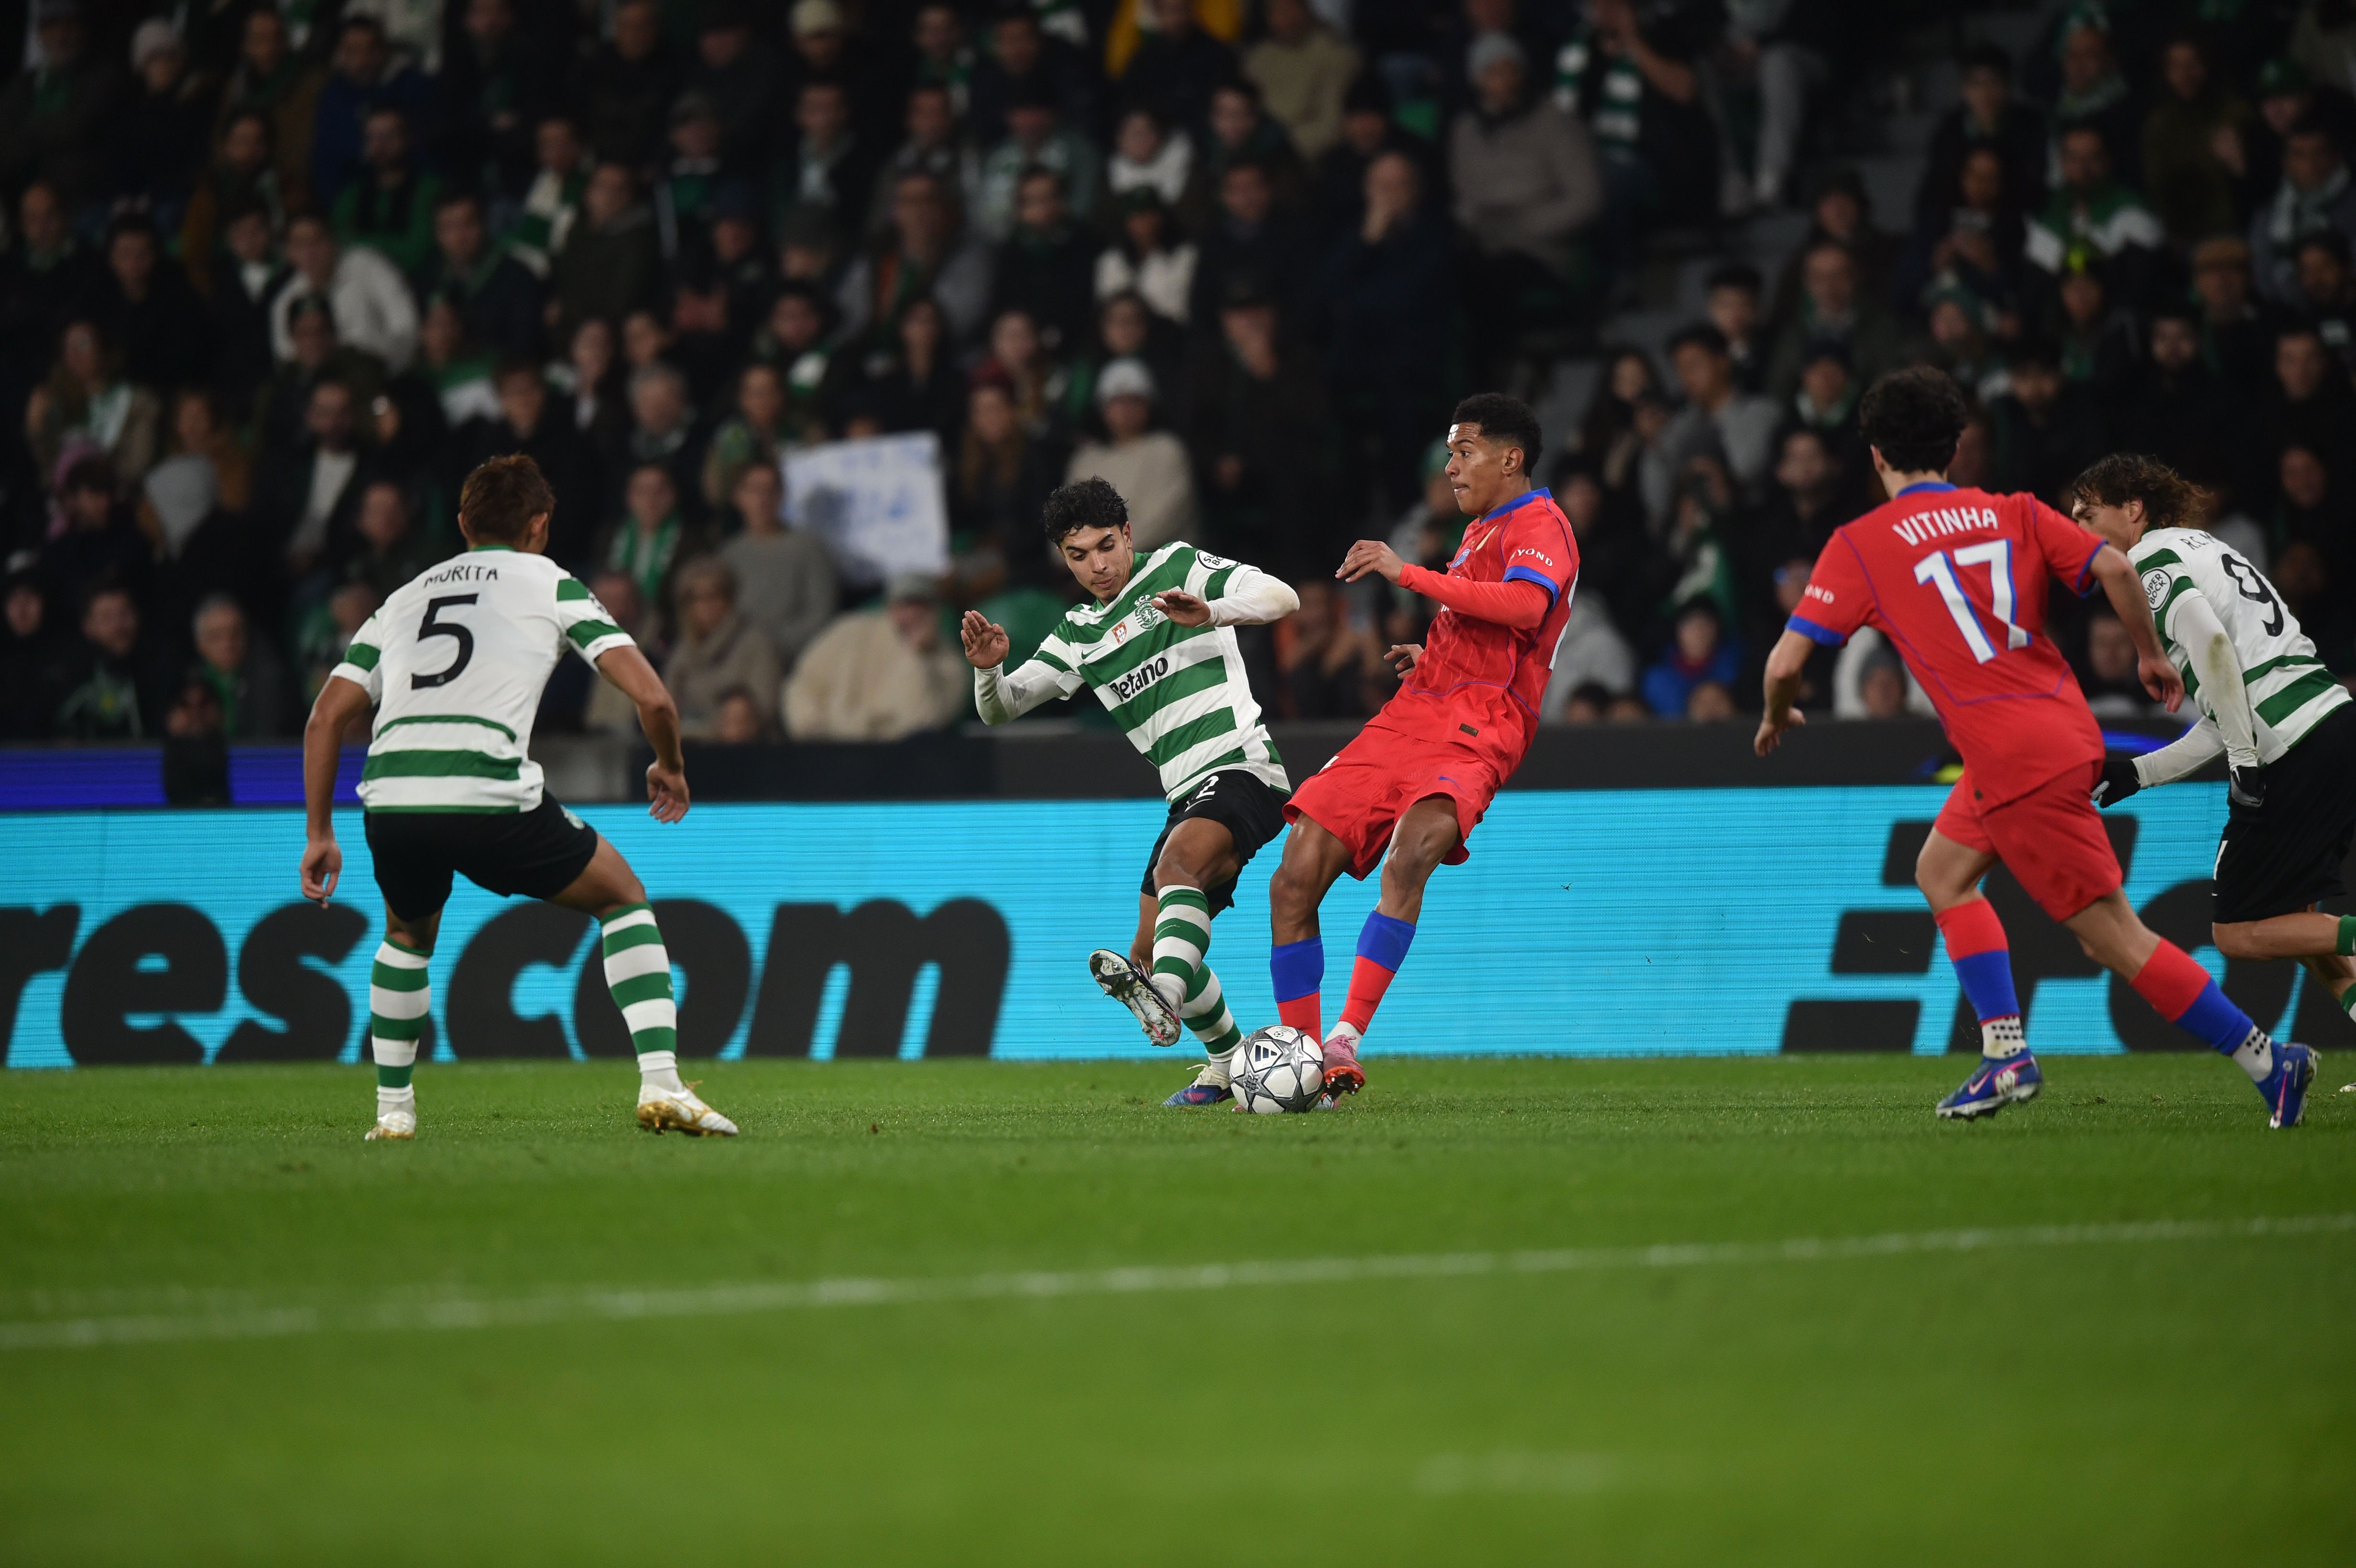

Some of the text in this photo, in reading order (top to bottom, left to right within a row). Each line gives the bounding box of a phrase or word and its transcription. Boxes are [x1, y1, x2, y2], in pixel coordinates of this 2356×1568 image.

[1892, 506, 1998, 546] VITINHA
[424, 566, 498, 588] MORITA
[2146, 574, 2163, 598] UPER
[1134, 594, 1150, 607] SCP
[1913, 538, 2032, 664] 17
[2149, 580, 2167, 604] BOCK
[2222, 554, 2284, 637] 9
[411, 593, 479, 690] 5
[1196, 775, 1219, 798] 2
